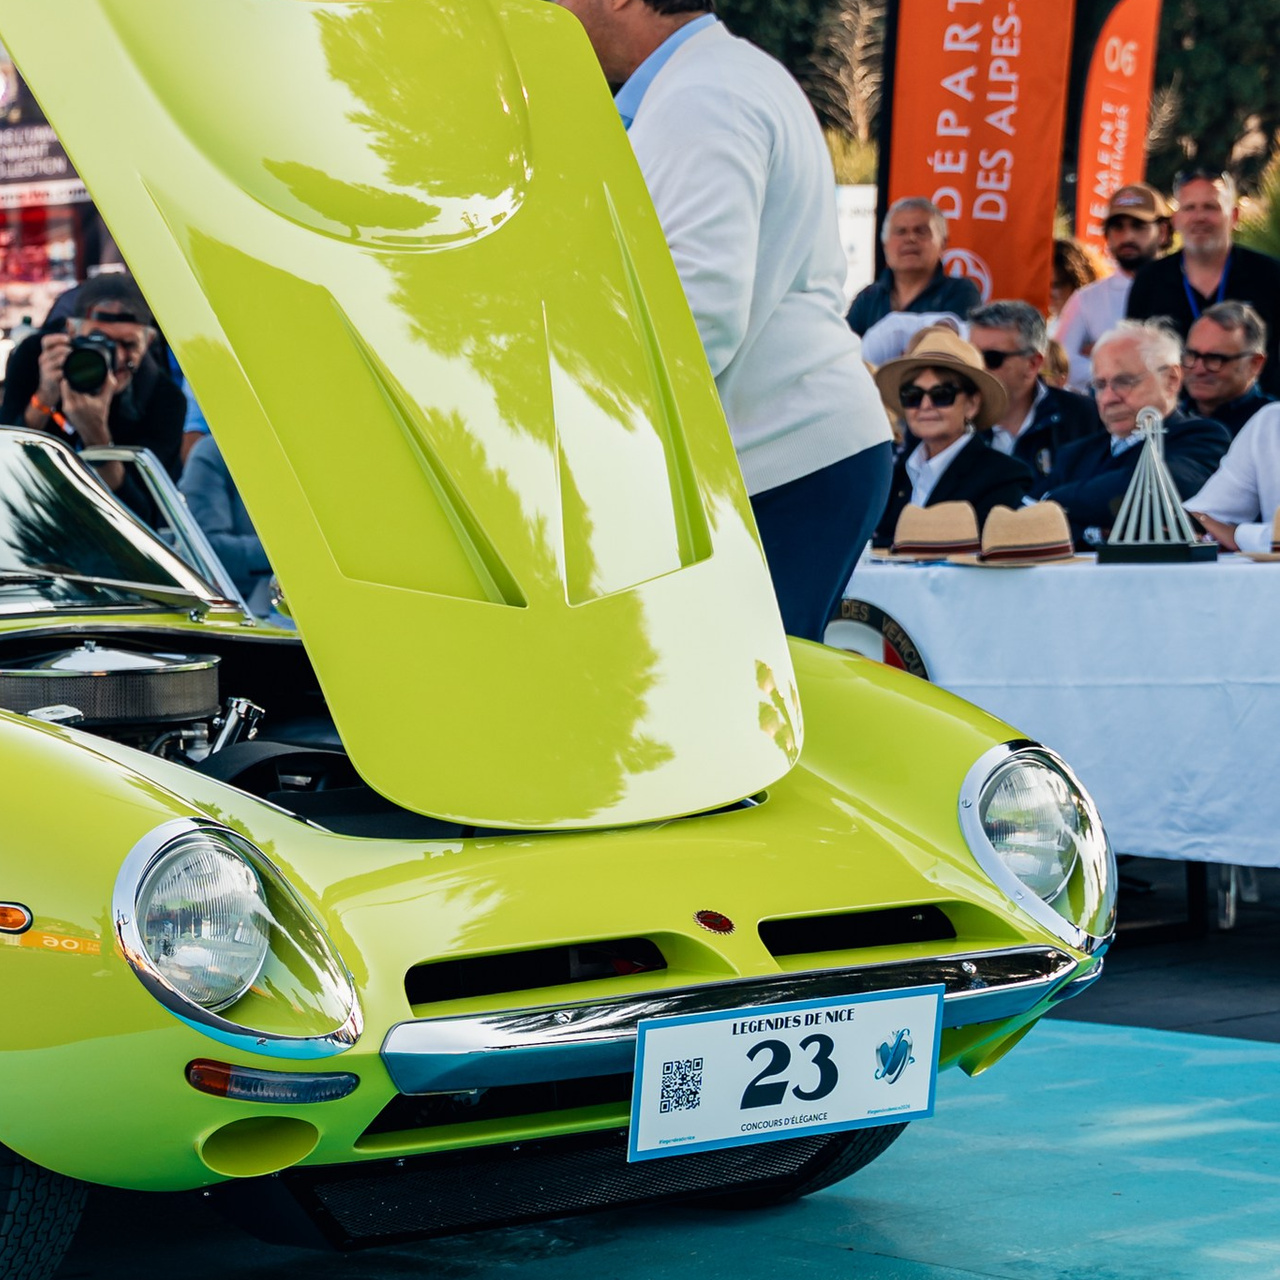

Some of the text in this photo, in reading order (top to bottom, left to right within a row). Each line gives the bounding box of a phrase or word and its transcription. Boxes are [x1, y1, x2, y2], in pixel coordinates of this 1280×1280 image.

[1104, 36, 1139, 77] 06
[962, 148, 1014, 222] DES
[732, 1008, 855, 1036] LEGENDES DE NICE
[740, 1033, 839, 1110] 23
[740, 1111, 828, 1132] CONCOURS D'ÉLÉGANCE
